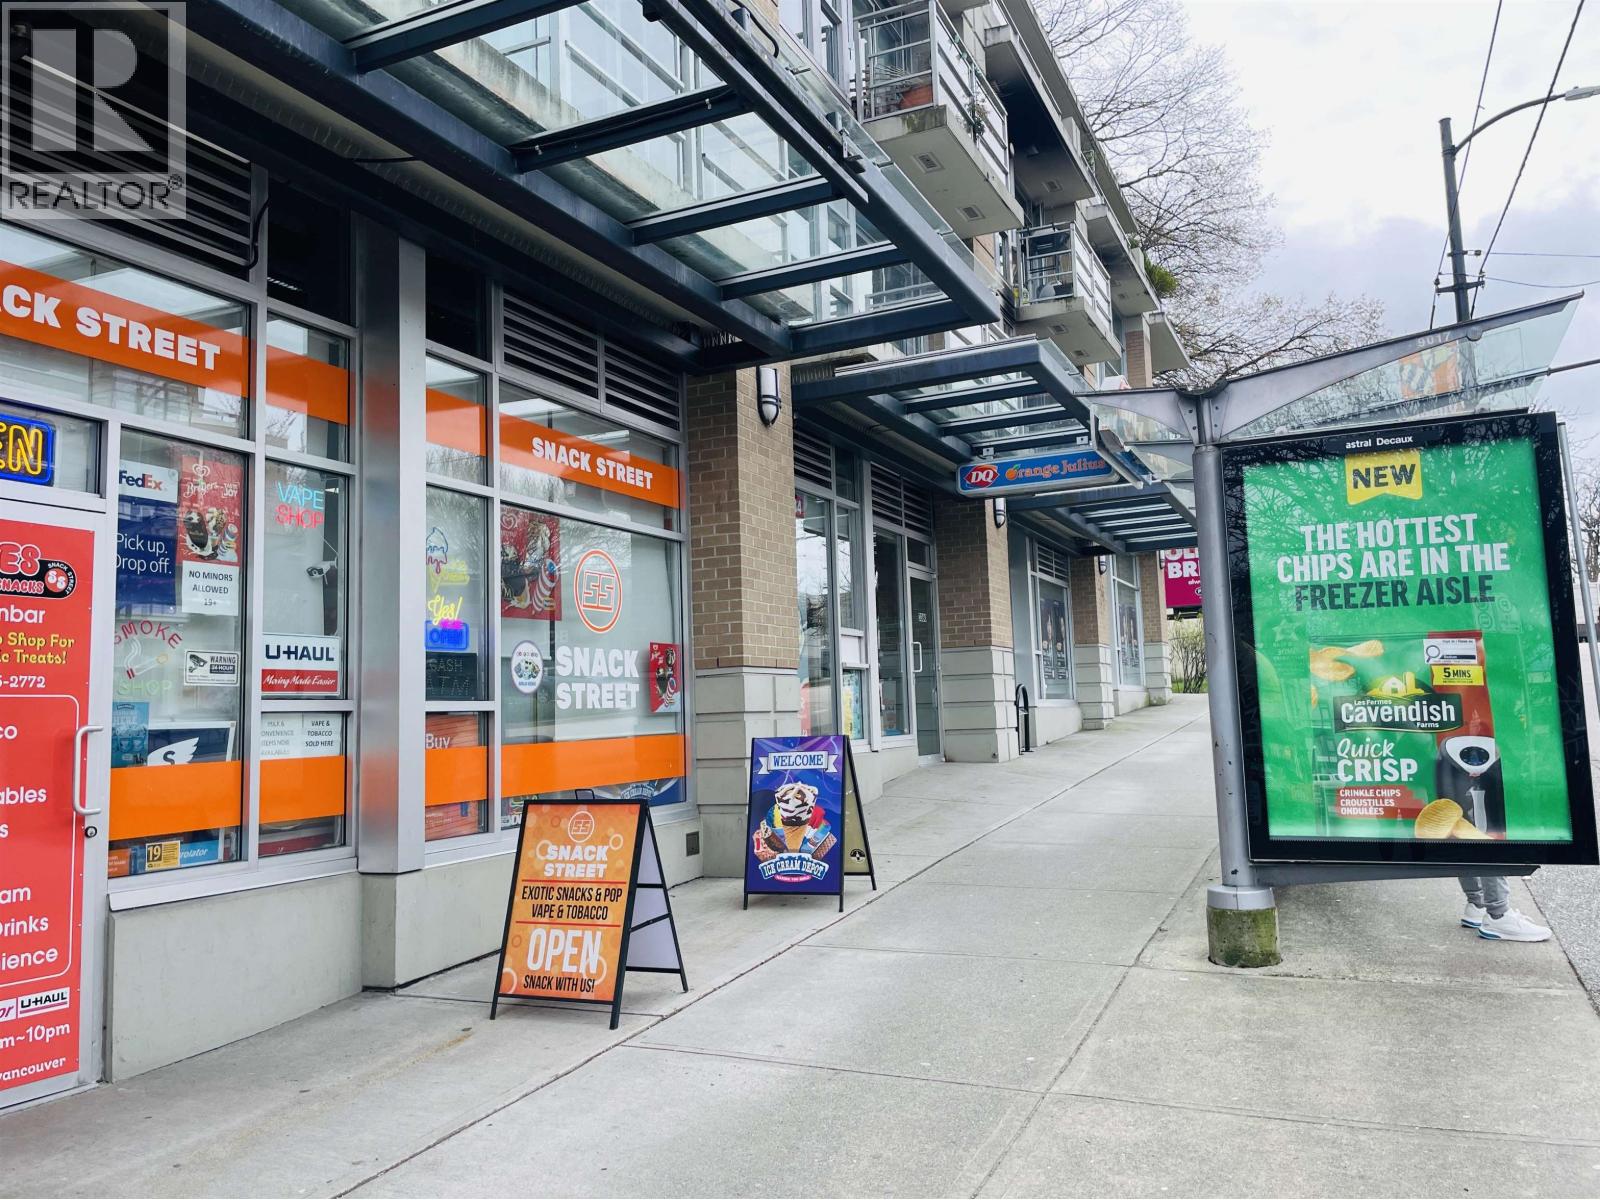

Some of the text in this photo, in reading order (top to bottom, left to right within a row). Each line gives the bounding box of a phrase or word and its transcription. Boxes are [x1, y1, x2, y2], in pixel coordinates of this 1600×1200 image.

[0, 284, 221, 371] CK STREET
[1346, 434, 1414, 449] astral Decaux
[532, 436, 653, 490] SNACK STREET
[1061, 457, 1105, 474] Julius
[119, 470, 162, 491] FedEx
[971, 469, 994, 484] DQ
[1352, 463, 1416, 490] NEW
[277, 482, 326, 510] VAPE
[275, 503, 325, 528] SHOP
[1301, 513, 1478, 552] THE HOTTEST
[116, 533, 168, 557] Pick up.
[149, 557, 172, 574] off.
[1167, 560, 1200, 579] BR
[1277, 543, 1511, 583] CHIPS ARE IN THE
[47, 562, 75, 595] SNACK STREET
[188, 570, 233, 582] NO MINORS
[0, 577, 45, 594] NACKS
[192, 584, 229, 595] ALLOWED
[1295, 574, 1496, 612] FREEZER AISLE
[427, 594, 463, 626] Yes!
[8, 632, 75, 651] Shop For
[14, 649, 68, 666] Treats!
[210, 656, 236, 665] WARNING
[265, 644, 336, 662] U-HAUL
[556, 646, 640, 678] SNACK
[263, 674, 290, 688] Moving
[290, 676, 311, 686] Made
[1443, 667, 1471, 678] 5 MINS
[117, 679, 173, 697] SHOP
[556, 682, 640, 710] STREET
[1341, 700, 1456, 723] Cavendish
[311, 720, 326, 728] VAPE
[307, 730, 333, 738] TOBACCO
[1336, 738, 1395, 758] Quick
[773, 754, 824, 767] WELCOME
[1340, 789, 1401, 797] CRINKLE CHIPS
[1340, 798, 1395, 807] CROUSTILLES
[1340, 807, 1385, 815] ONDULÉES
[146, 844, 162, 861] 19
[546, 845, 610, 861] SNACK
[544, 863, 607, 878] STREET
[764, 859, 824, 876] ICE CREAM DEPOT
[521, 885, 623, 902] EXOTIC SNACKS & POP
[532, 903, 609, 920] VAPE & TOBACCO
[527, 928, 602, 974] OPEN
[523, 975, 595, 993] SNACK WITH US!
[20, 990, 68, 1009] U-HAUL
